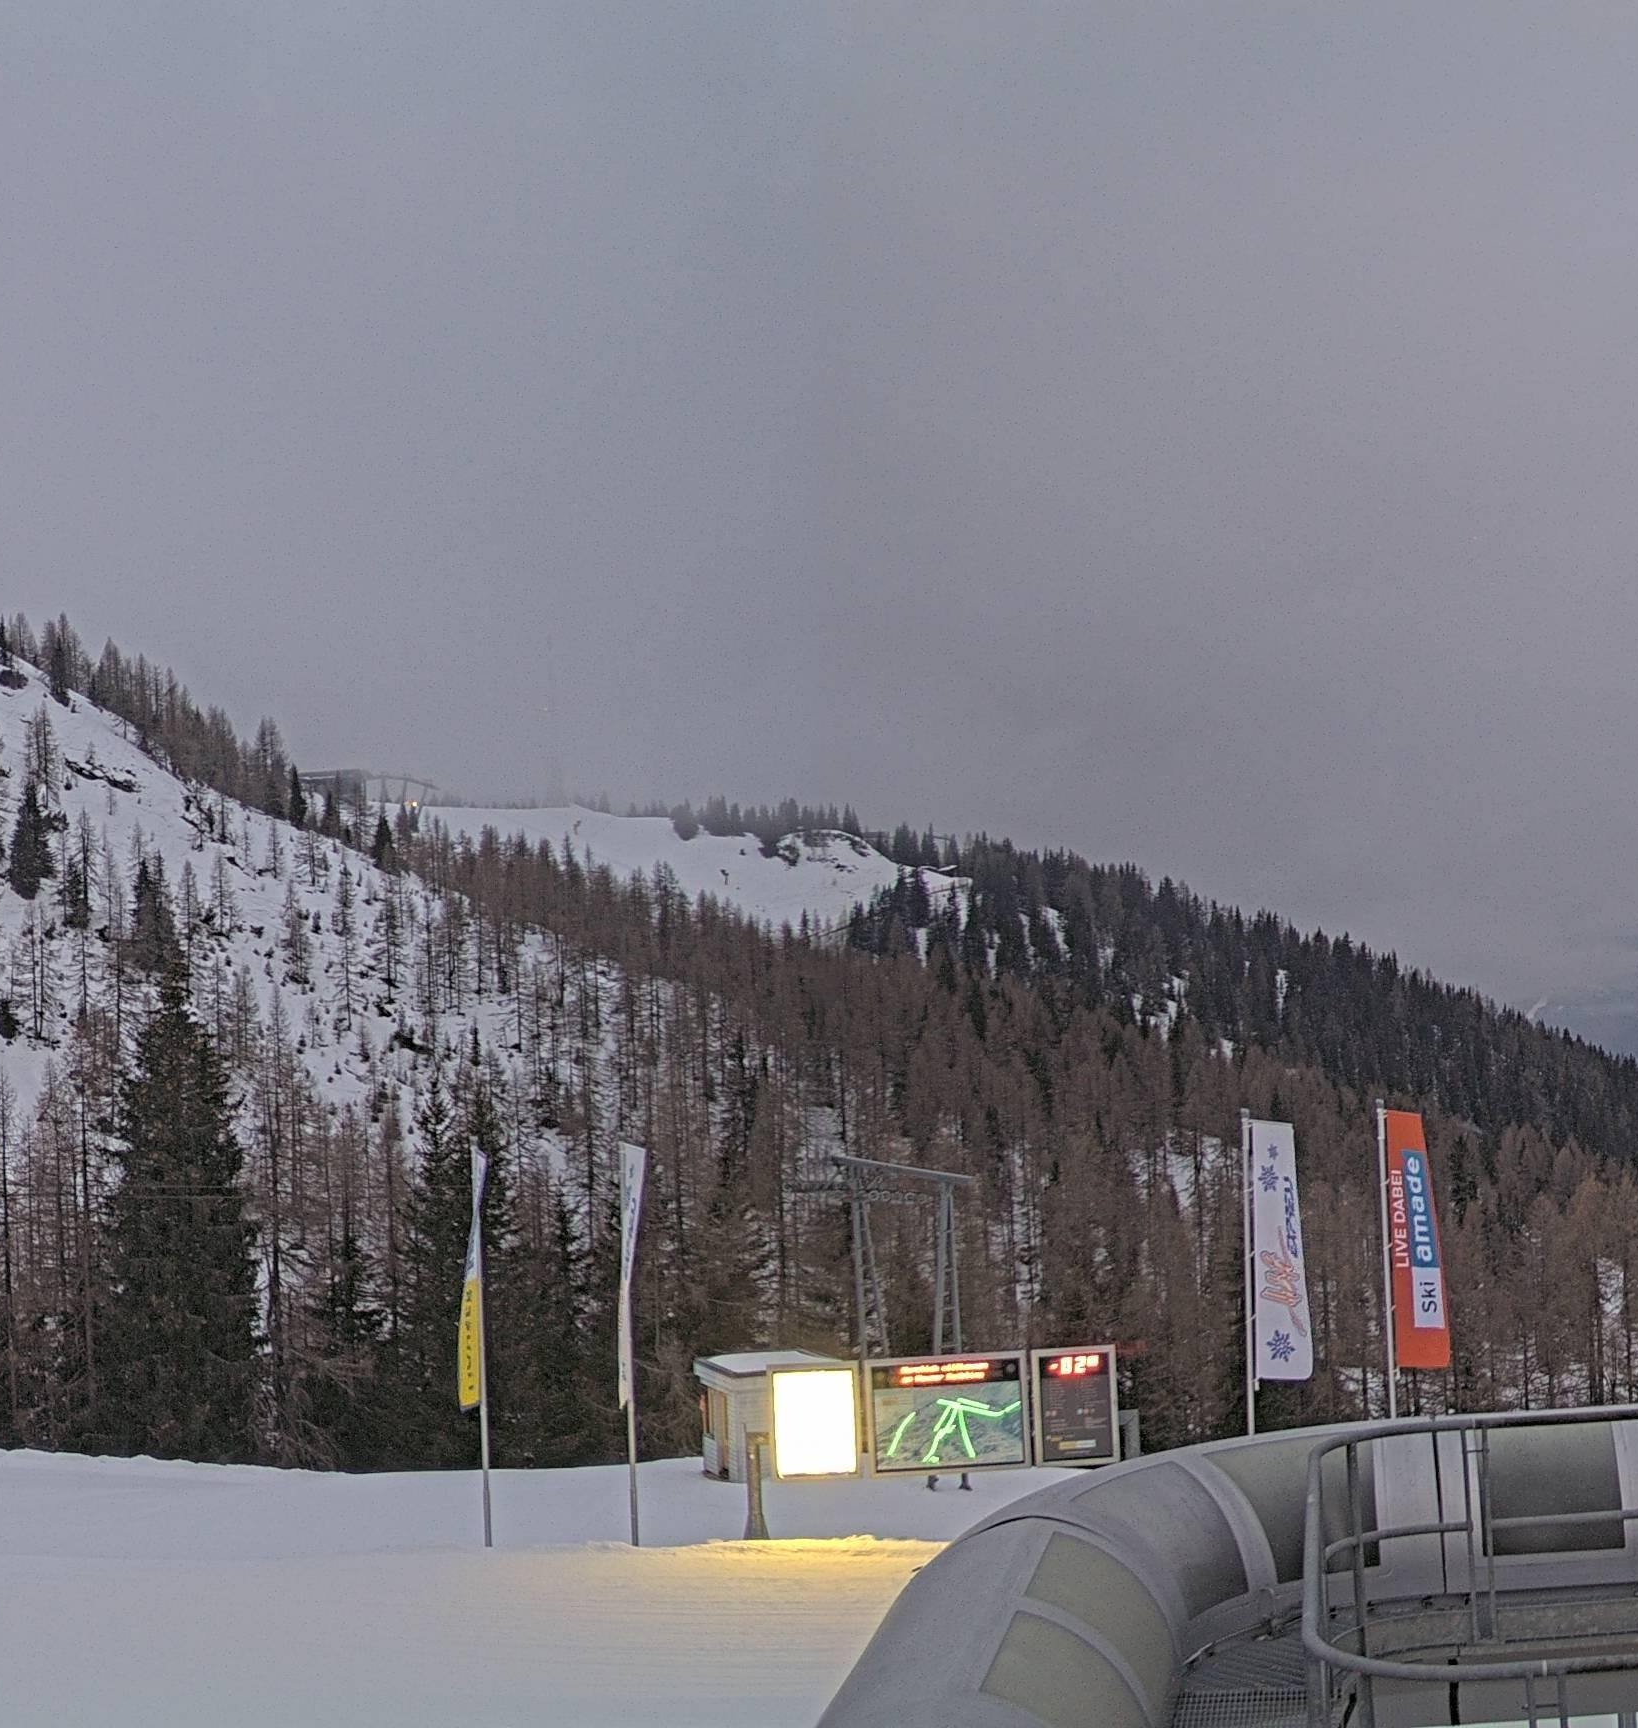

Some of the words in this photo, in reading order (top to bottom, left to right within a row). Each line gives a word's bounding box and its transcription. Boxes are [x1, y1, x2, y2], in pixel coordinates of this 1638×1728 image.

[1390, 1169, 1407, 1225] DABEI
[1396, 1228, 1410, 1268] LIVE
[1420, 1281, 1437, 1313] Ski
